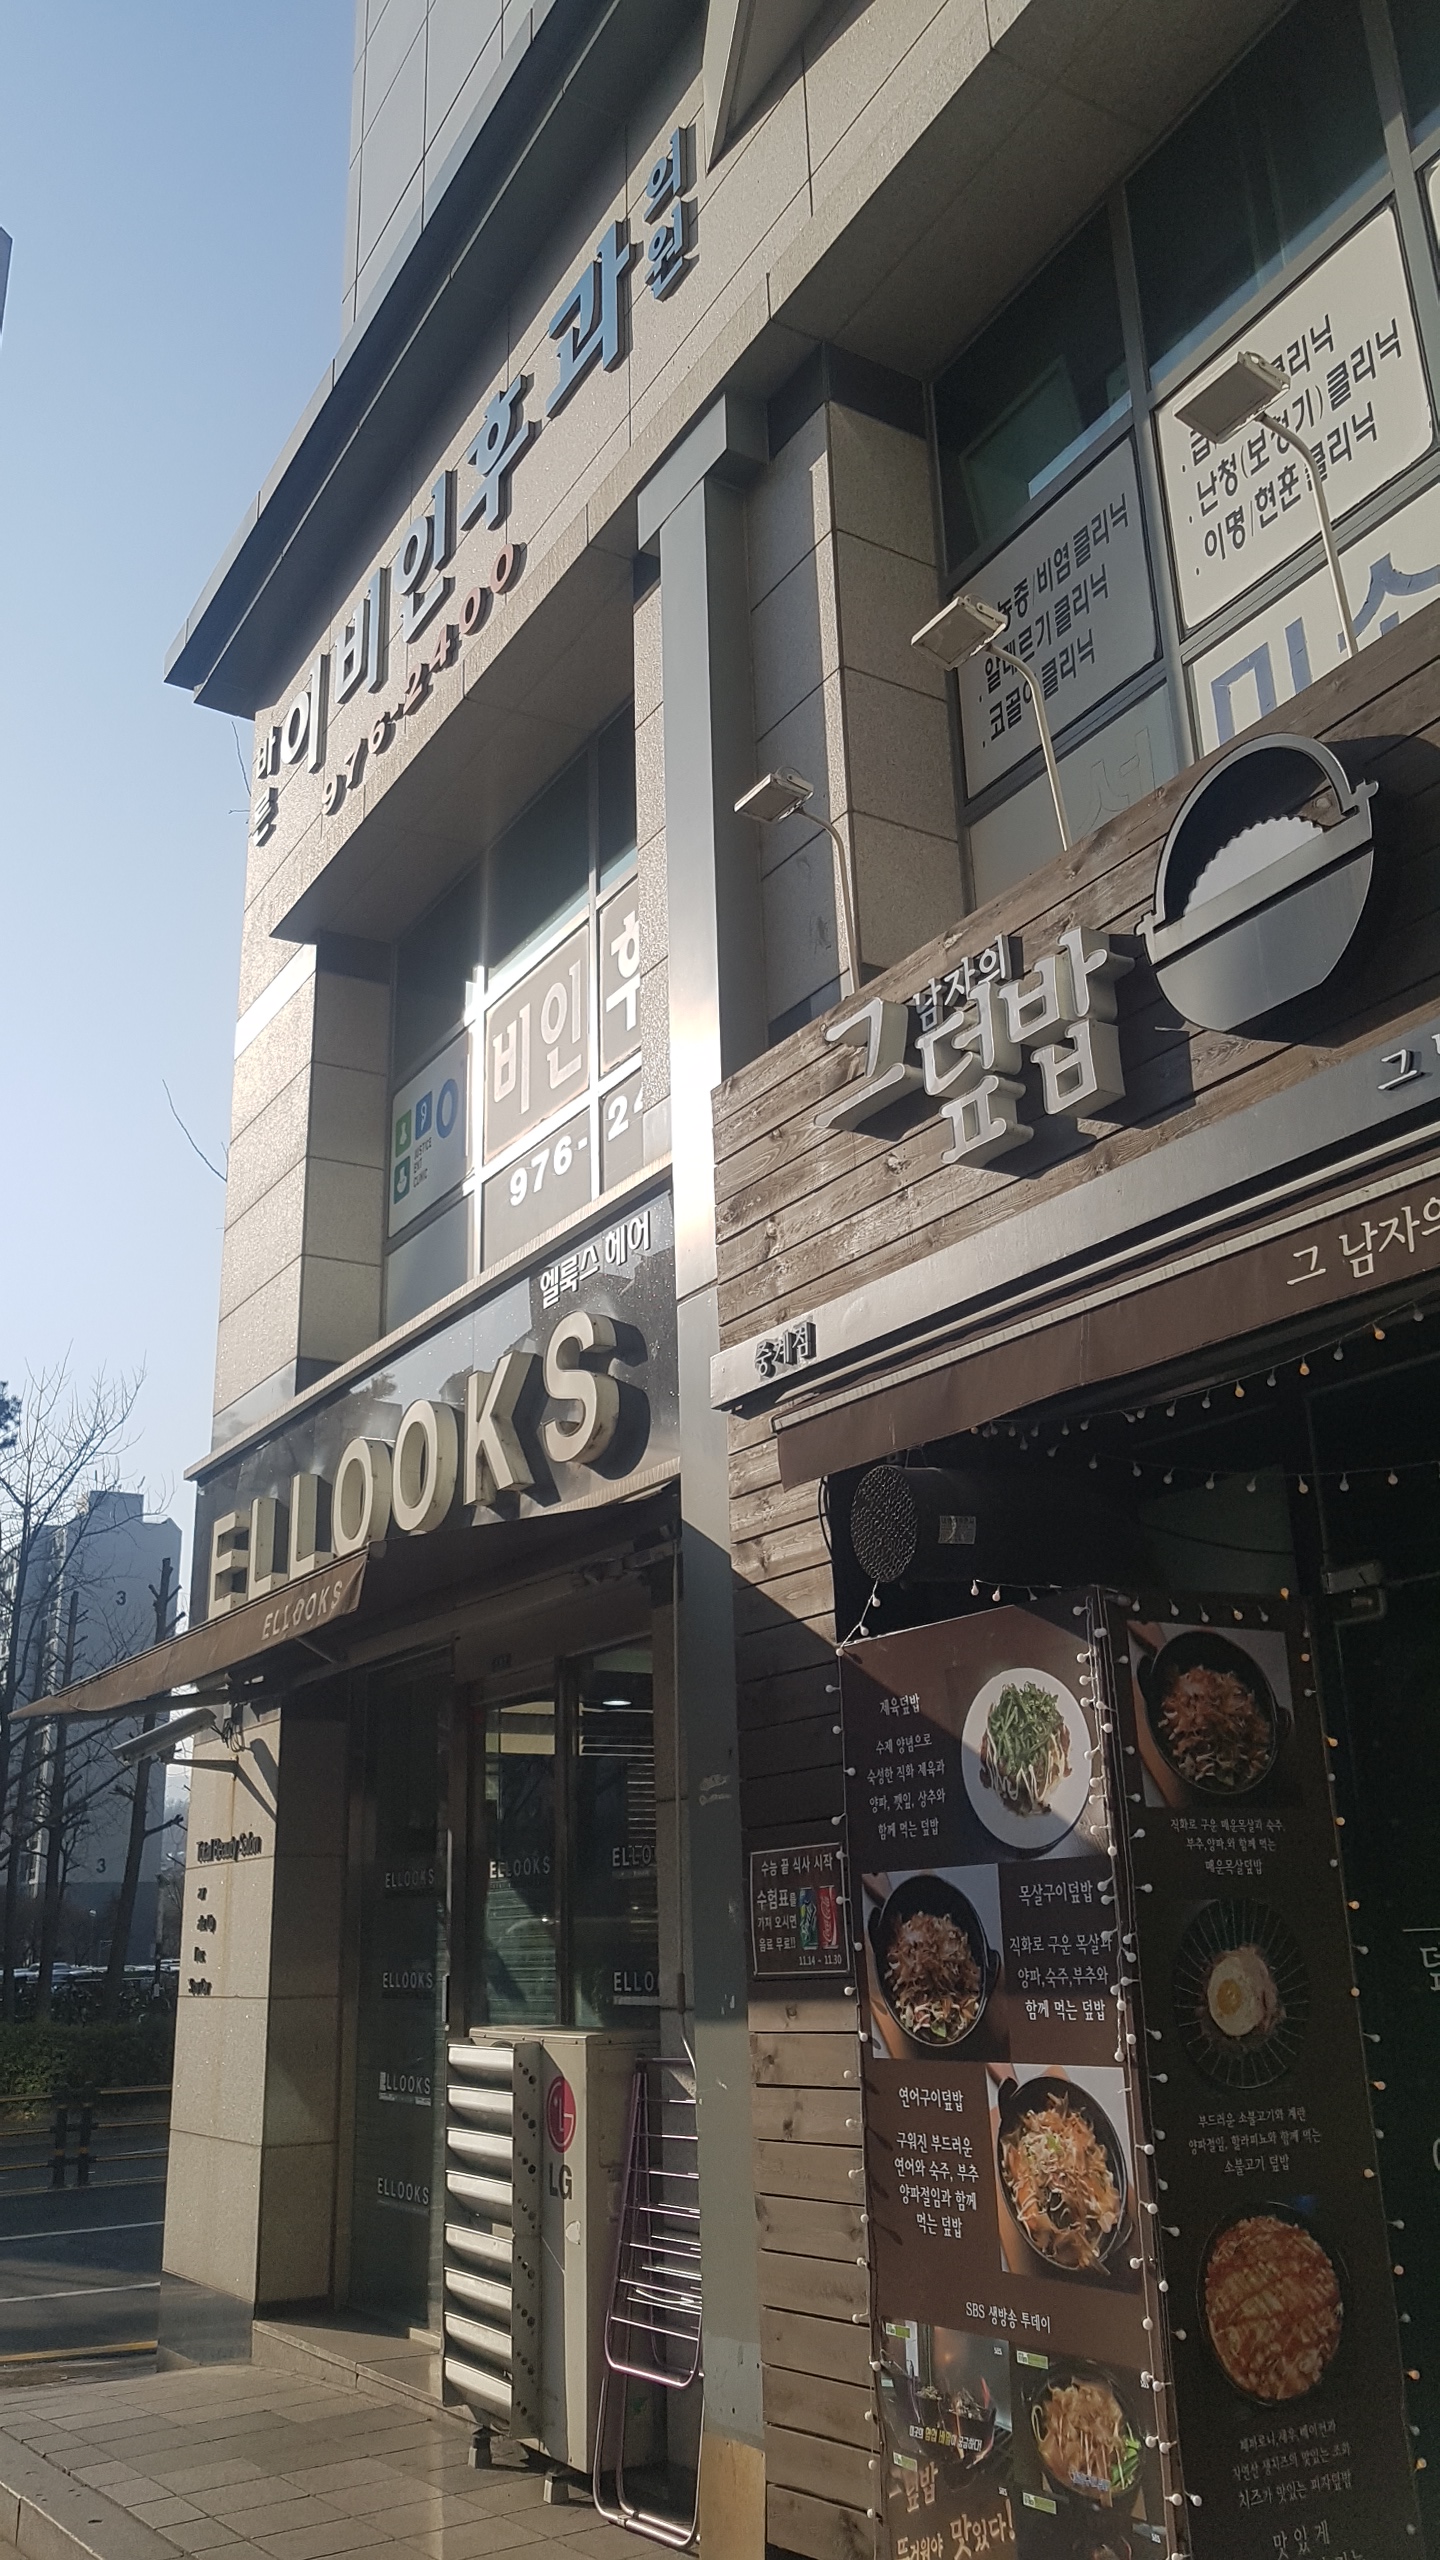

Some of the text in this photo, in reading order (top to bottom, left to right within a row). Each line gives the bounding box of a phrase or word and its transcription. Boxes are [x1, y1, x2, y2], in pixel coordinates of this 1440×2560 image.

[1326, 318, 1402, 412] 클리닉
[280, 220, 632, 774] 이비인후과
[644, 126, 700, 302] 의원
[1204, 463, 1302, 561] 이명/현훈
[1073, 493, 1129, 569] 클리닉
[1054, 563, 1109, 638] 클리닉
[1041, 628, 1095, 701] 클리닉
[322, 541, 528, 817] 976-2400
[912, 933, 1010, 1033] 남자의
[914, 925, 1111, 1166] 덮밥
[1377, 1048, 1418, 1091] 그
[540, 1208, 653, 1310] 엘룩스 헤어
[1286, 1245, 1327, 1286] 그
[755, 1320, 816, 1378] 중계점
[207, 1310, 622, 1622] ELLOOKS
[115, 1590, 127, 1606] 3
[879, 1692, 920, 1717] 제육덮밥
[876, 1732, 933, 1756] 수제 양념으로
[867, 1761, 946, 1786] 숙성한 직화 제육과
[918, 1787, 946, 1808] 상추와
[878, 1817, 939, 1841] 함께 먹는 덮밥
[1170, 1818, 1198, 1833] 직화로
[1200, 1817, 1218, 1833] 구운
[1258, 1837, 1277, 1853] 먹는
[385, 1867, 435, 1889] ELLOOKS
[489, 1855, 551, 1879] ELLOOKS
[761, 1860, 778, 1877] 수능
[792, 1854, 811, 1874] 식사
[813, 1852, 834, 1871] 시작
[1205, 1858, 1263, 1876] 매운목살덮밥
[756, 1887, 797, 1912] 수험표를
[1018, 1879, 1094, 1907] 목살구이덮밥
[774, 1914, 797, 1930] 오시면
[759, 1938, 773, 1953] 음료
[1009, 1935, 1044, 1958] 직화로
[1047, 1934, 1073, 1956] 구운
[382, 1971, 433, 1991] ELLOOKS
[1024, 1999, 1106, 2021] 함께 먹는 덮밥
[898, 2086, 964, 2113] 연어구이덮밥
[1197, 2112, 1236, 2129] 부드러운
[1237, 2108, 1284, 2127] 소불고기와
[896, 2131, 973, 2158] 구워진 부드러운
[1280, 2129, 1300, 2147] 함께
[1302, 2127, 1322, 2144] 먹는
[894, 2157, 926, 2178] 연어와
[956, 2164, 980, 2184] 부추
[1224, 2153, 1290, 2177] 소불고기 덮밥
[377, 2177, 430, 2206] ELLOOKS
[549, 2163, 573, 2201] LG
[899, 2184, 978, 2212] 양파절임과 함께
[916, 2212, 963, 2239] 먹는 덮밥
[965, 2301, 1051, 2334] SBS 생방송 투데이
[1238, 2468, 1353, 2510] 치즈가 맛있는 피자덮밥
[949, 2498, 1016, 2560] 맛있다!
